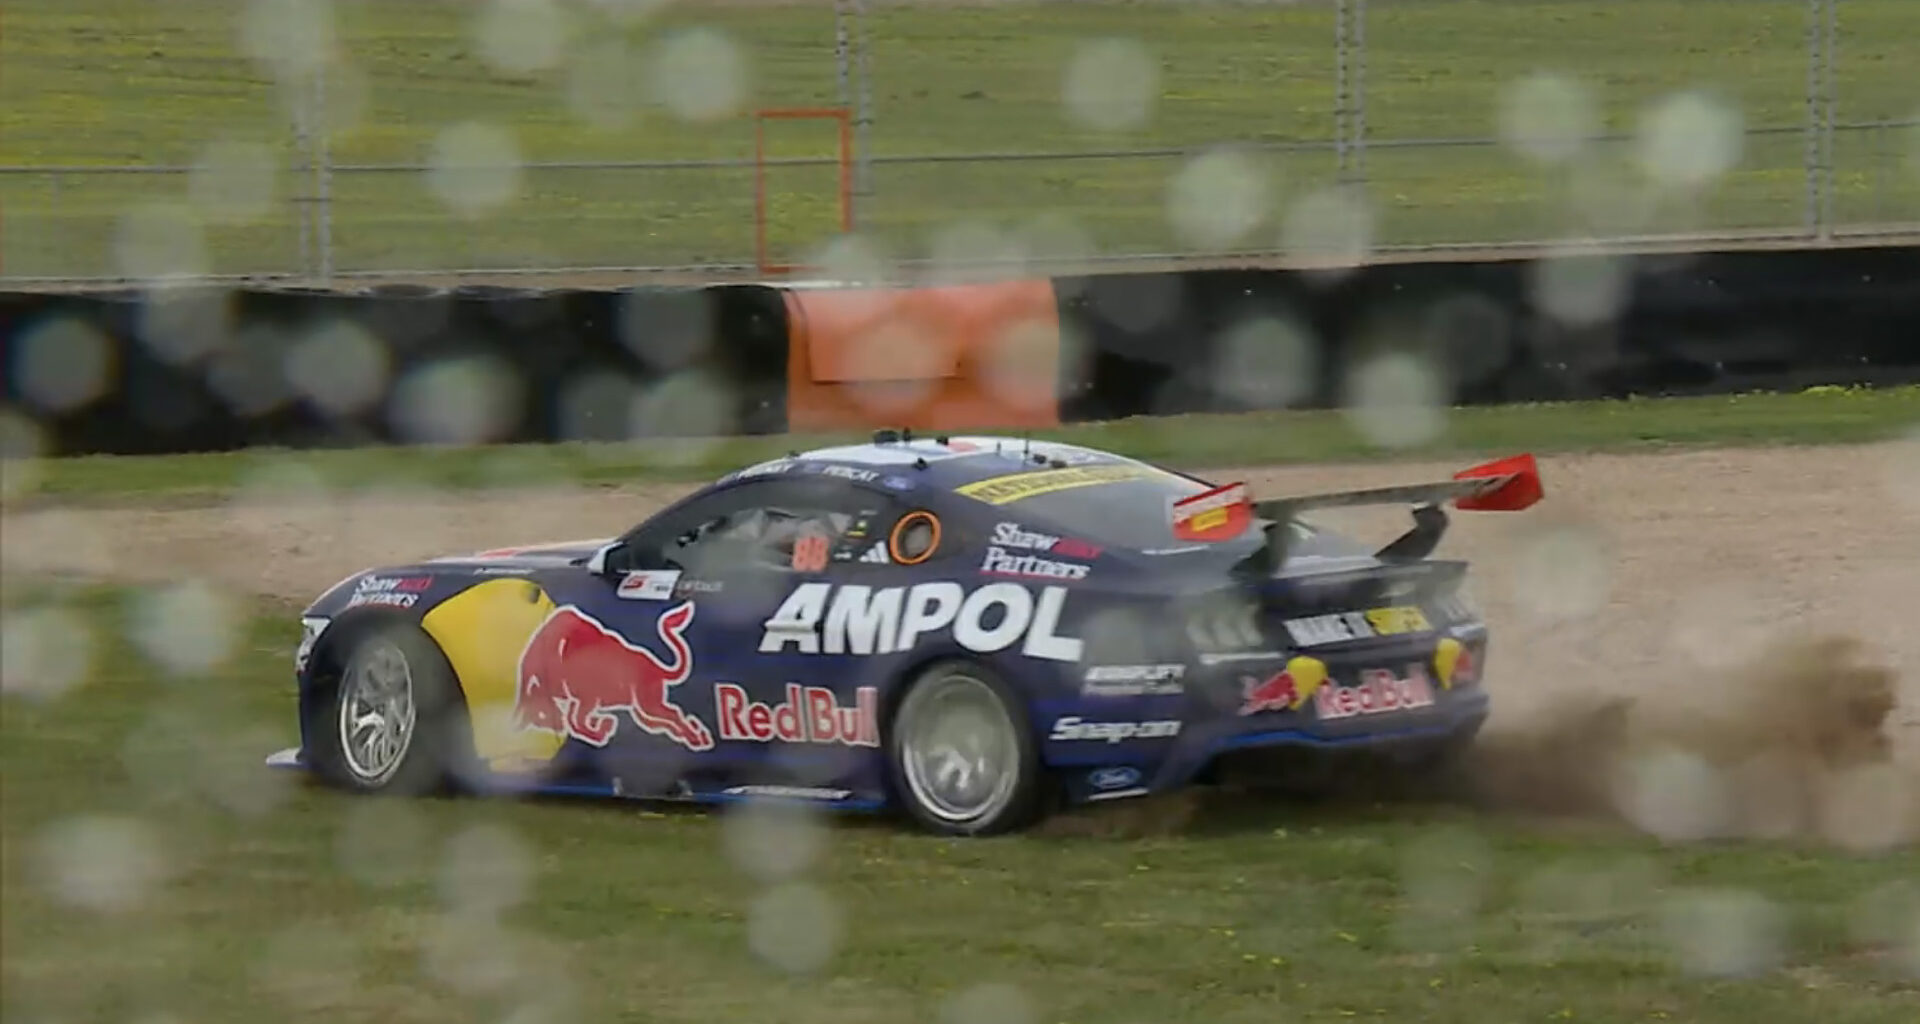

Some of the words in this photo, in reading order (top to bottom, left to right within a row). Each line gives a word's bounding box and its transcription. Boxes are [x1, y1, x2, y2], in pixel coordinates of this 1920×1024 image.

[792, 535, 829, 573] 88
[990, 522, 1060, 551] Shaw
[981, 546, 1090, 580] Partners
[758, 582, 1085, 662] AMPOL
[714, 682, 805, 742] Red
[1048, 716, 1183, 744] Snap-on
